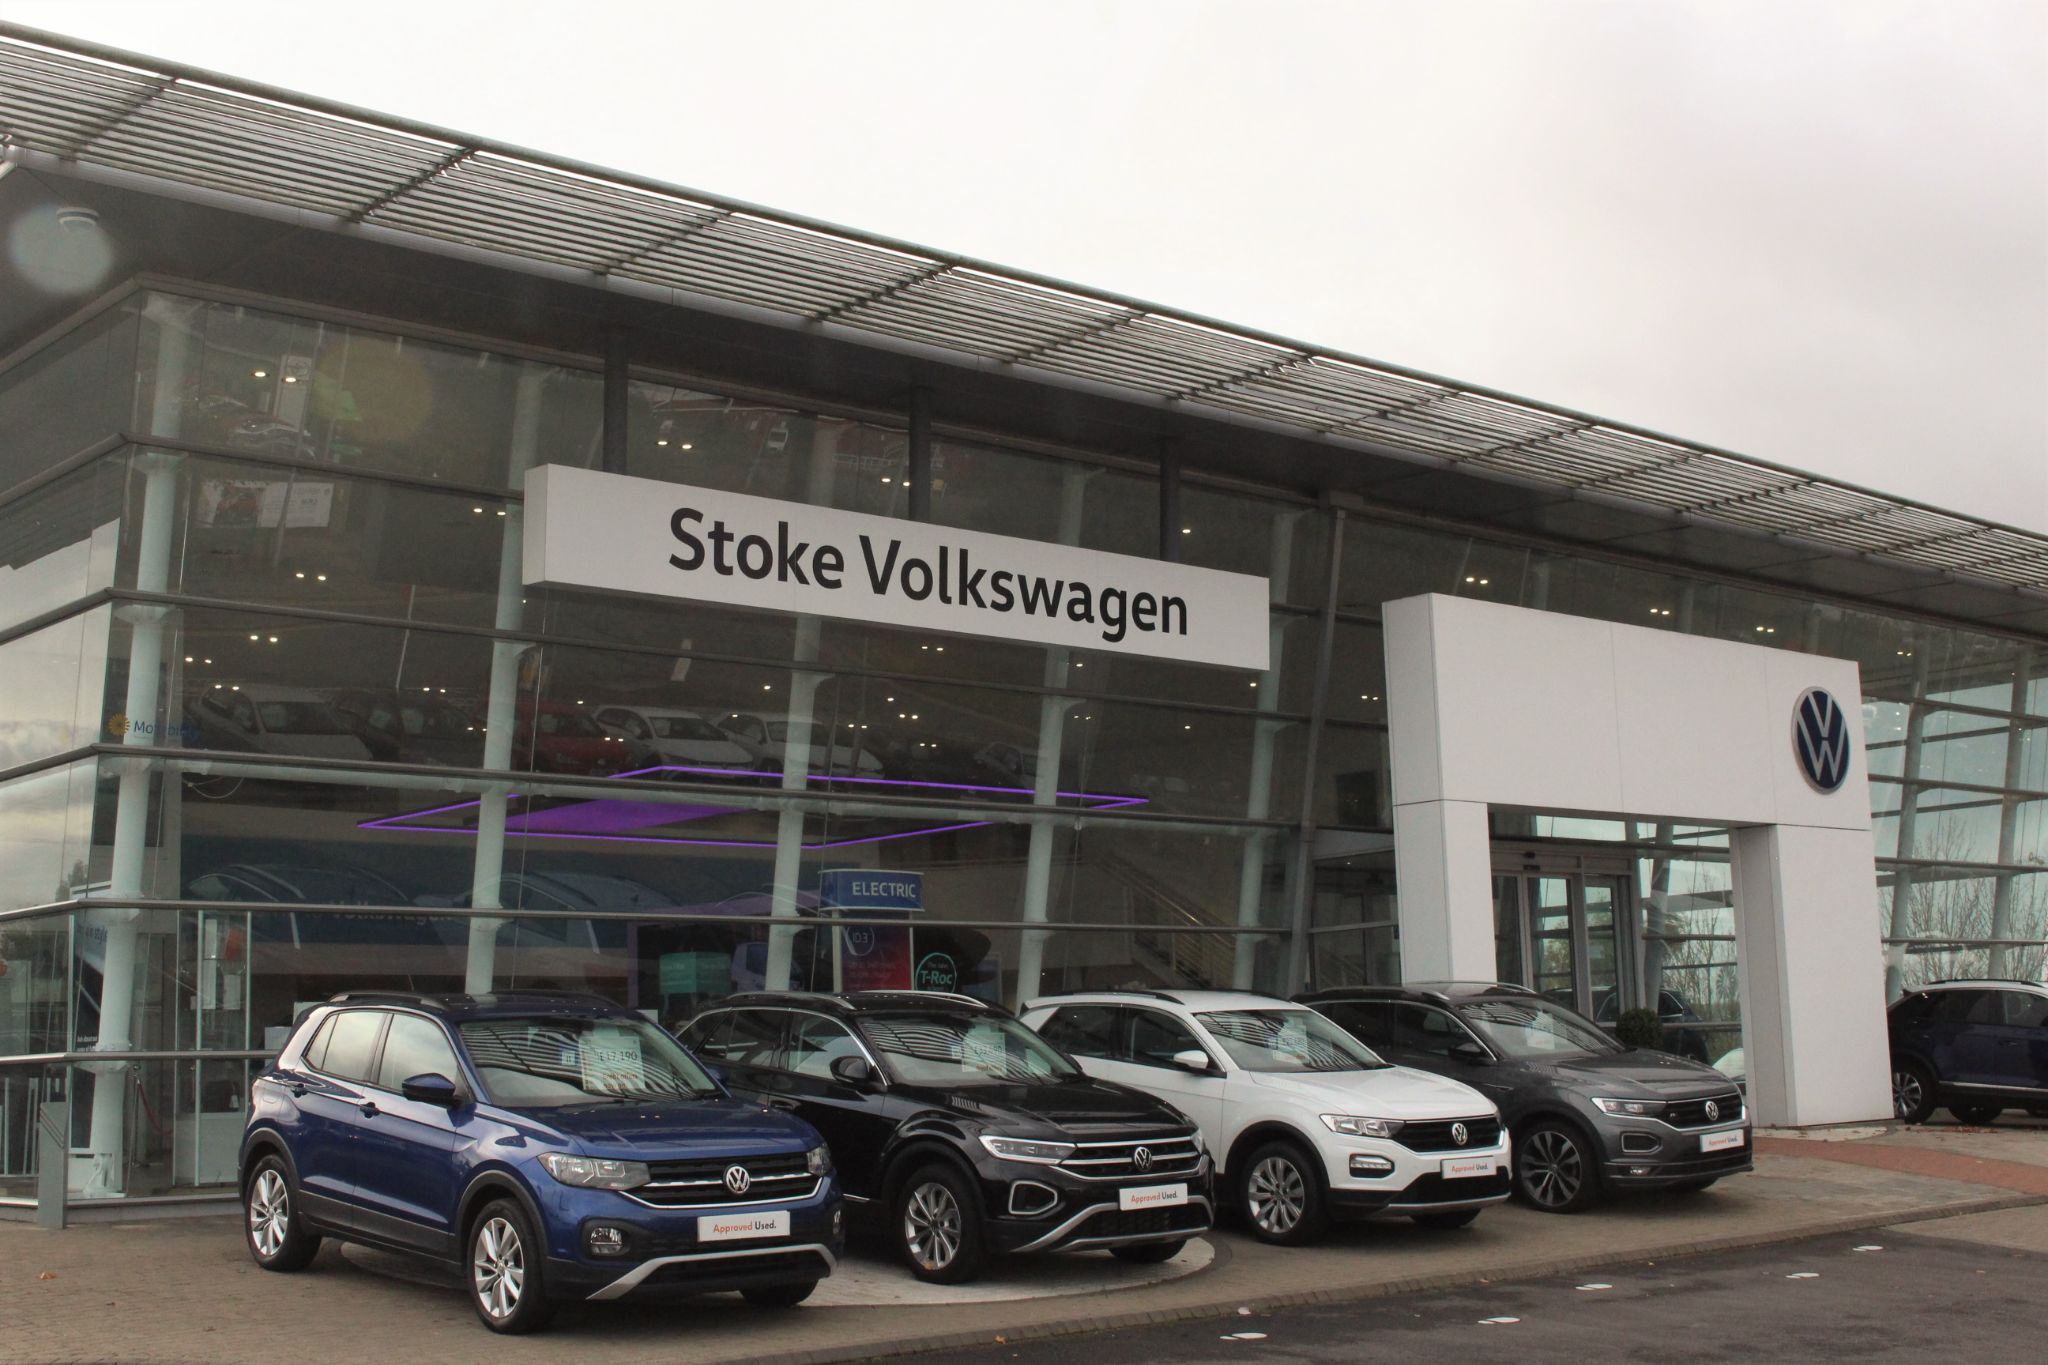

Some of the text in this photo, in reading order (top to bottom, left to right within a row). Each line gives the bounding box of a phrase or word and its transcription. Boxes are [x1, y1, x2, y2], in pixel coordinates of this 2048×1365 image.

[668, 508, 1188, 643] Stoke Volkswagen
[133, 721, 199, 741] Mobily
[852, 882, 916, 898] ELECTRIC
[920, 970, 952, 984] T-Roc
[1131, 1193, 1161, 1203] Approved
[713, 1220, 777, 1234] Approved Used.
